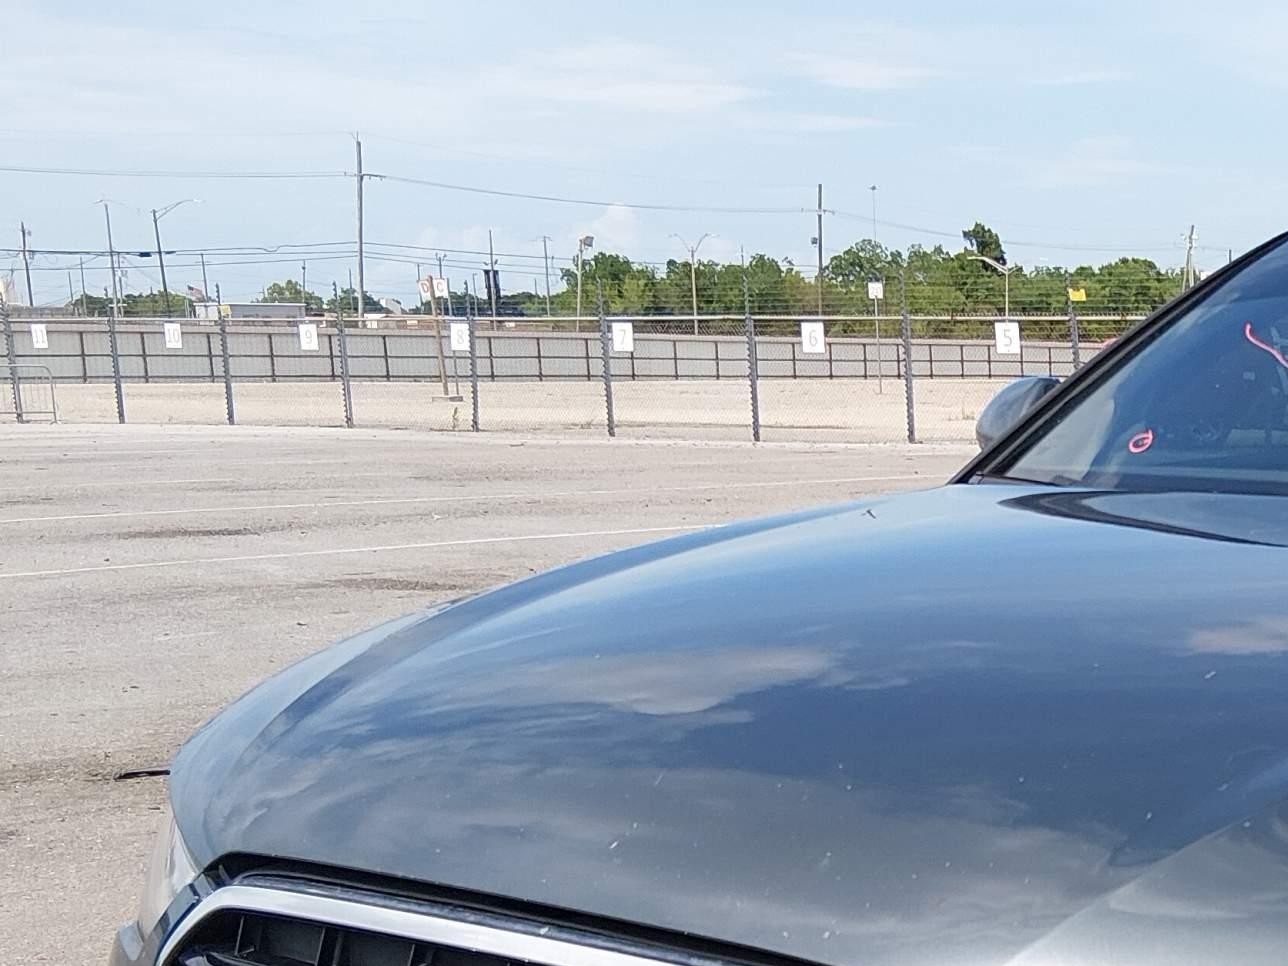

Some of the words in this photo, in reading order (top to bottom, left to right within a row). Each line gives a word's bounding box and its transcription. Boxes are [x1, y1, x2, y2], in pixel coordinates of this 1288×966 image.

[33, 328, 46, 345] 11
[167, 328, 180, 344] 10
[304, 329, 314, 345] 9
[456, 329, 465, 345] 8
[619, 328, 626, 345] 7
[809, 329, 818, 347] 6
[1003, 329, 1013, 347] 5
